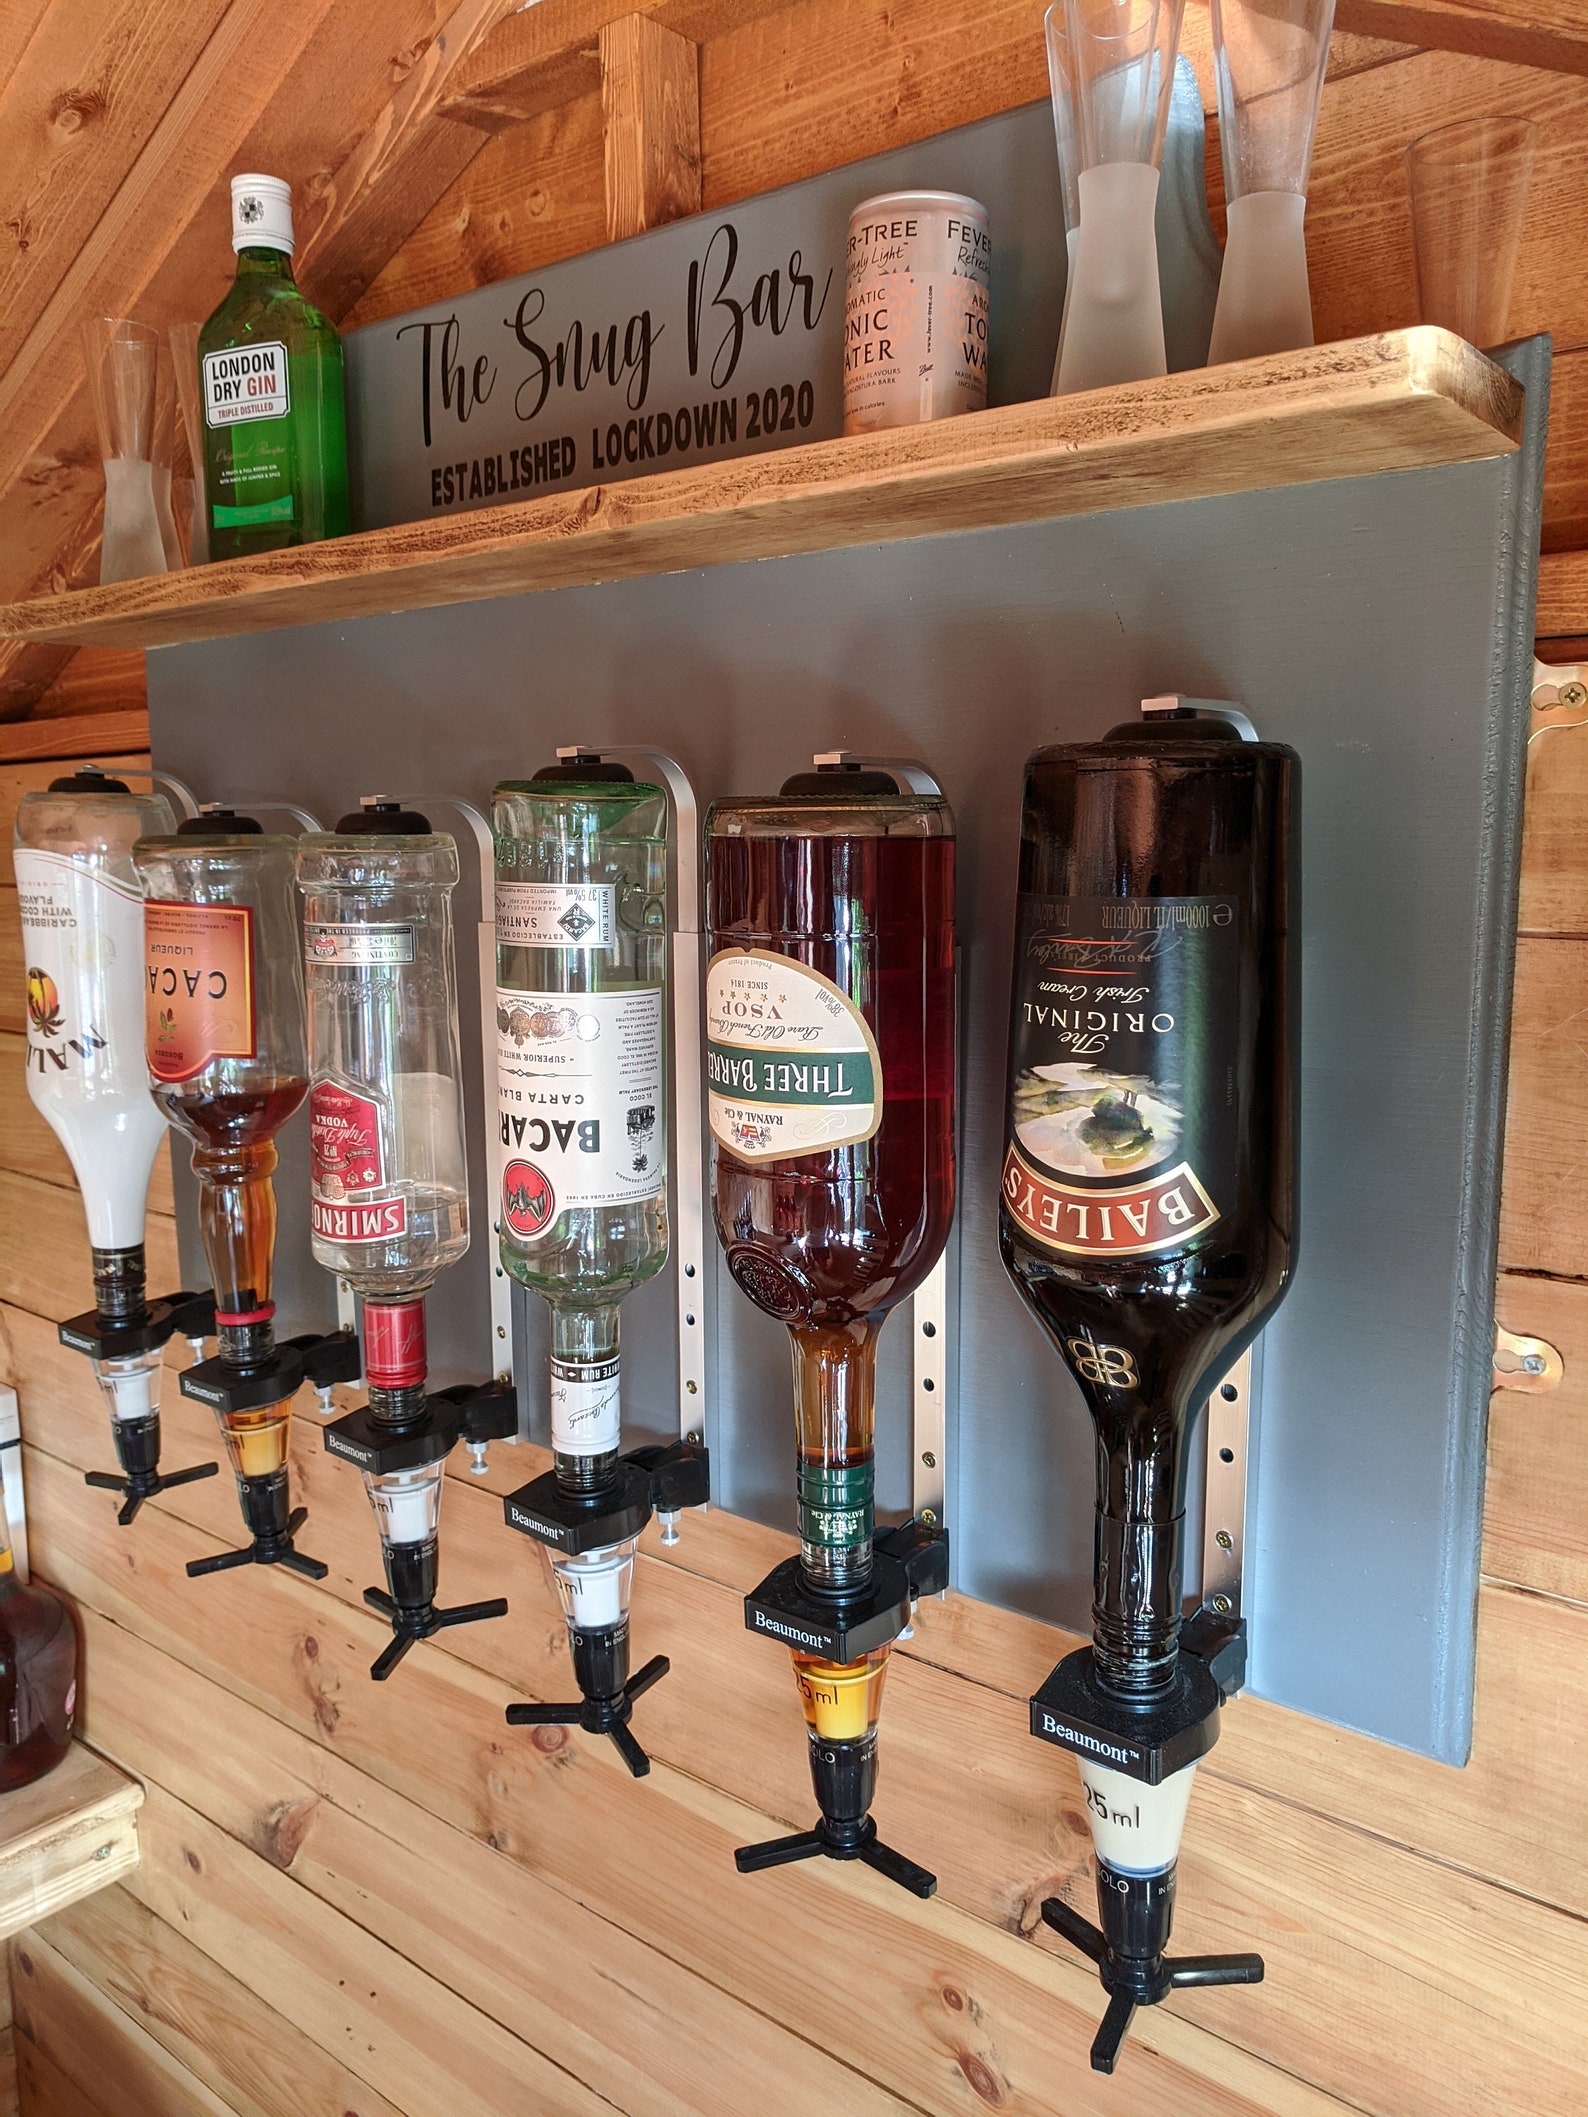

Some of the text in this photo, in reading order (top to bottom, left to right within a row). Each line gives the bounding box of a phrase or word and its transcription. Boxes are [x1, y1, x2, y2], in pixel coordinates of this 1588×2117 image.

[871, 245, 905, 269] Light
[396, 223, 834, 448] The Snug Bar
[212, 351, 276, 381] LONDON
[866, 367, 902, 379] FLAVOURS
[213, 373, 277, 402] DRY GIN
[877, 377, 896, 386] BARK
[218, 402, 274, 419] TRIPLE DISTILLED
[431, 380, 815, 507] ESTABLISHED LOCKDOWN 2020
[41, 906, 73, 916] WITH
[1101, 900, 1151, 929] LIQUEUR
[511, 932, 564, 941] ESTABLECIDO
[150, 944, 194, 957] LIQUEUR
[1094, 953, 1151, 963] PRODUCT
[731, 979, 769, 990] SINCE 1814
[1037, 981, 1150, 1005] Irish Cream
[722, 1000, 783, 1020] VSOP
[1023, 1002, 1175, 1034] ORIGINAL
[730, 1021, 764, 1039] French
[762, 1025, 787, 1040] Old
[787, 1026, 825, 1042] Rare
[1057, 1031, 1110, 1054] The
[503, 1049, 521, 1061] WHITE
[523, 1054, 567, 1064] SUPERIOR
[762, 1061, 855, 1099] THREE
[528, 1092, 585, 1105] CARTA
[629, 1094, 646, 1102] COCO
[315, 1113, 350, 1128] VODKA
[724, 1107, 784, 1126] RAYNAL & Cie
[615, 1187, 647, 1198] ESTABLECIDO
[581, 1368, 601, 1382] RUM
[832, 1509, 865, 1521] RAYNAL
